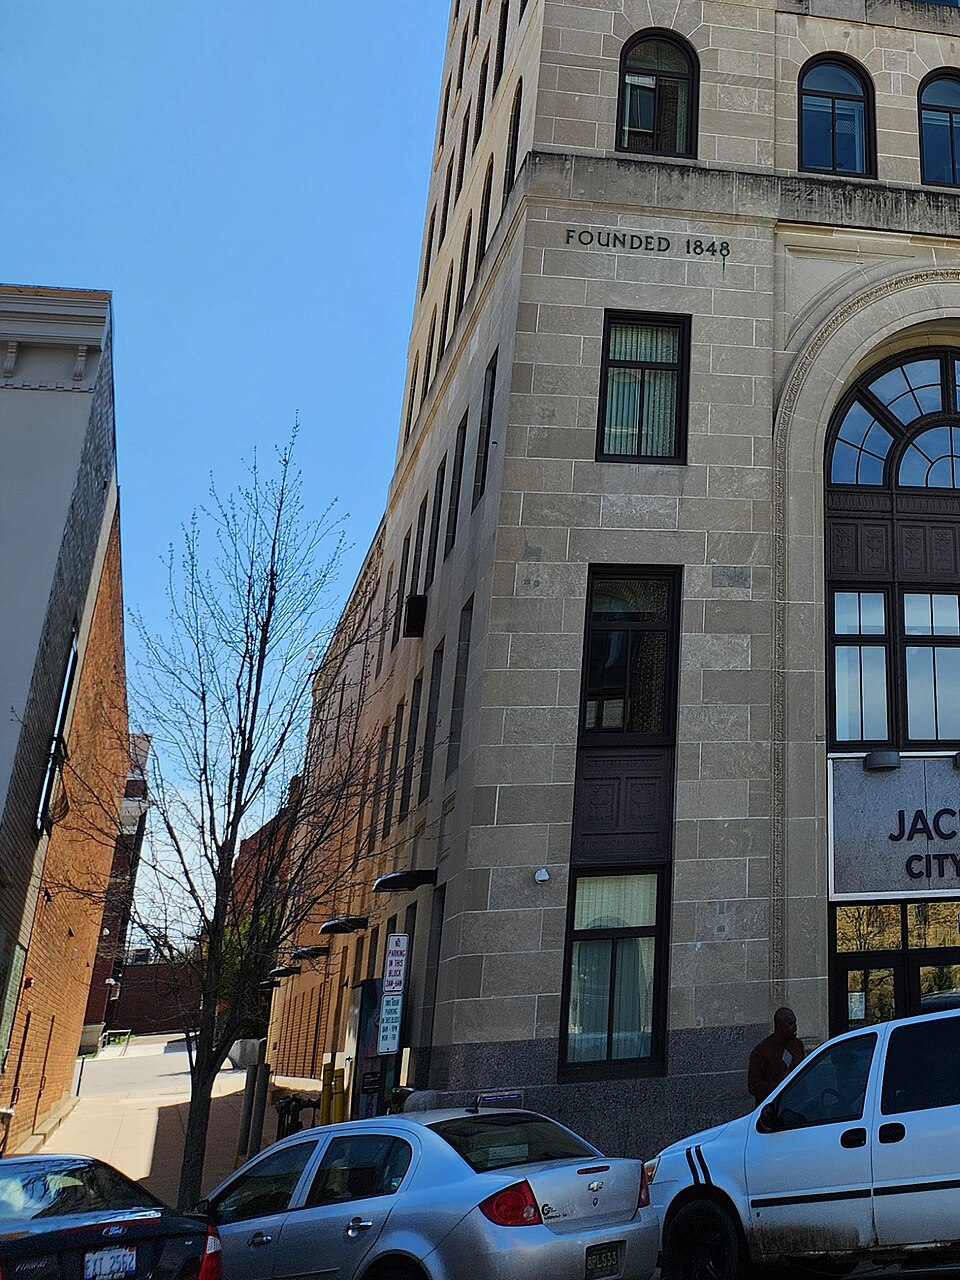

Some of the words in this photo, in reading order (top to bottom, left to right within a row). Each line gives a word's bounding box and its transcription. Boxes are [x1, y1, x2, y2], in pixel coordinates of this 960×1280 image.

[565, 229, 671, 252] FOUNDED
[685, 239, 731, 257] 1848
[388, 949, 406, 957] PARKING
[395, 959, 404, 968] THIS
[388, 969, 402, 978] BLOCK
